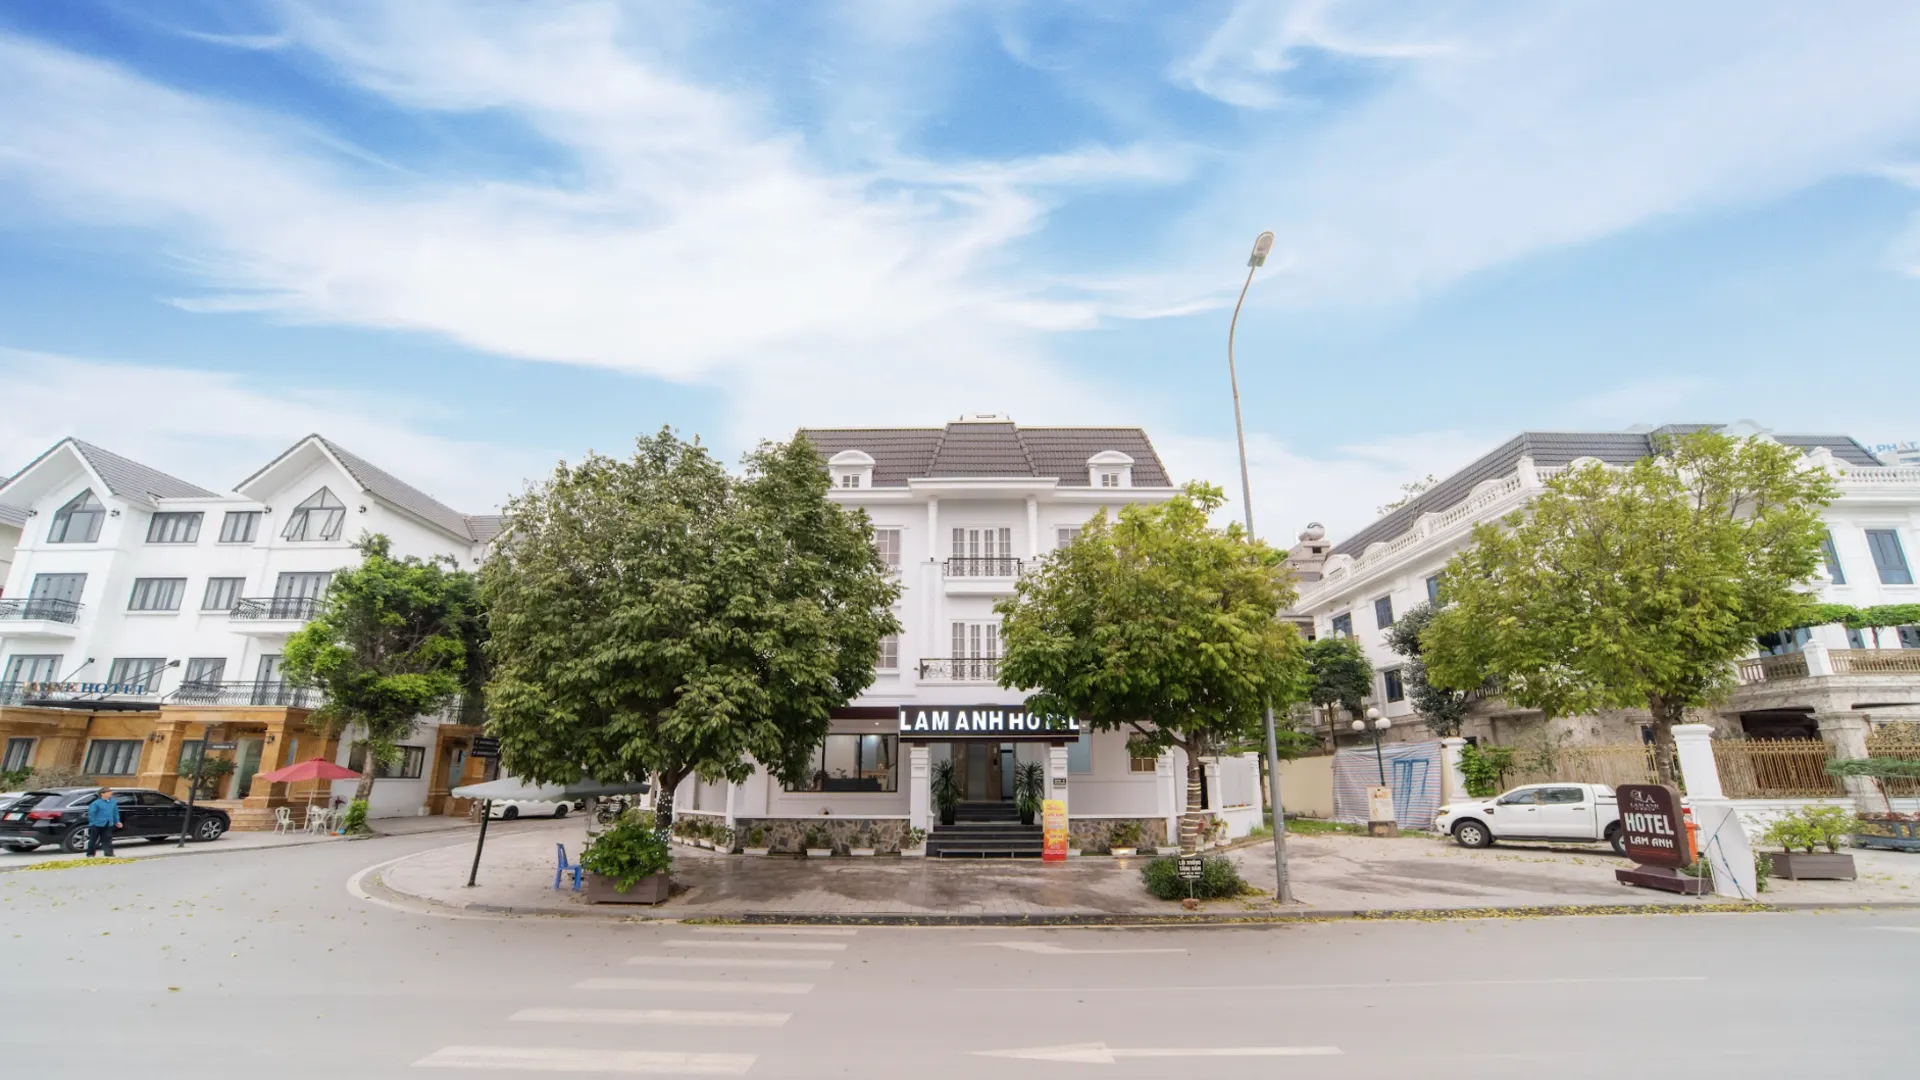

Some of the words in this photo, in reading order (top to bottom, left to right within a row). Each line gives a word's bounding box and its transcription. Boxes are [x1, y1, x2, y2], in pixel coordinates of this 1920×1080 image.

[900, 710, 950, 731] LAM
[954, 710, 1003, 731] ANH
[1623, 812, 1675, 836] HOTEL
[1629, 835, 1650, 846] LAM
[1651, 837, 1674, 848] ANH
